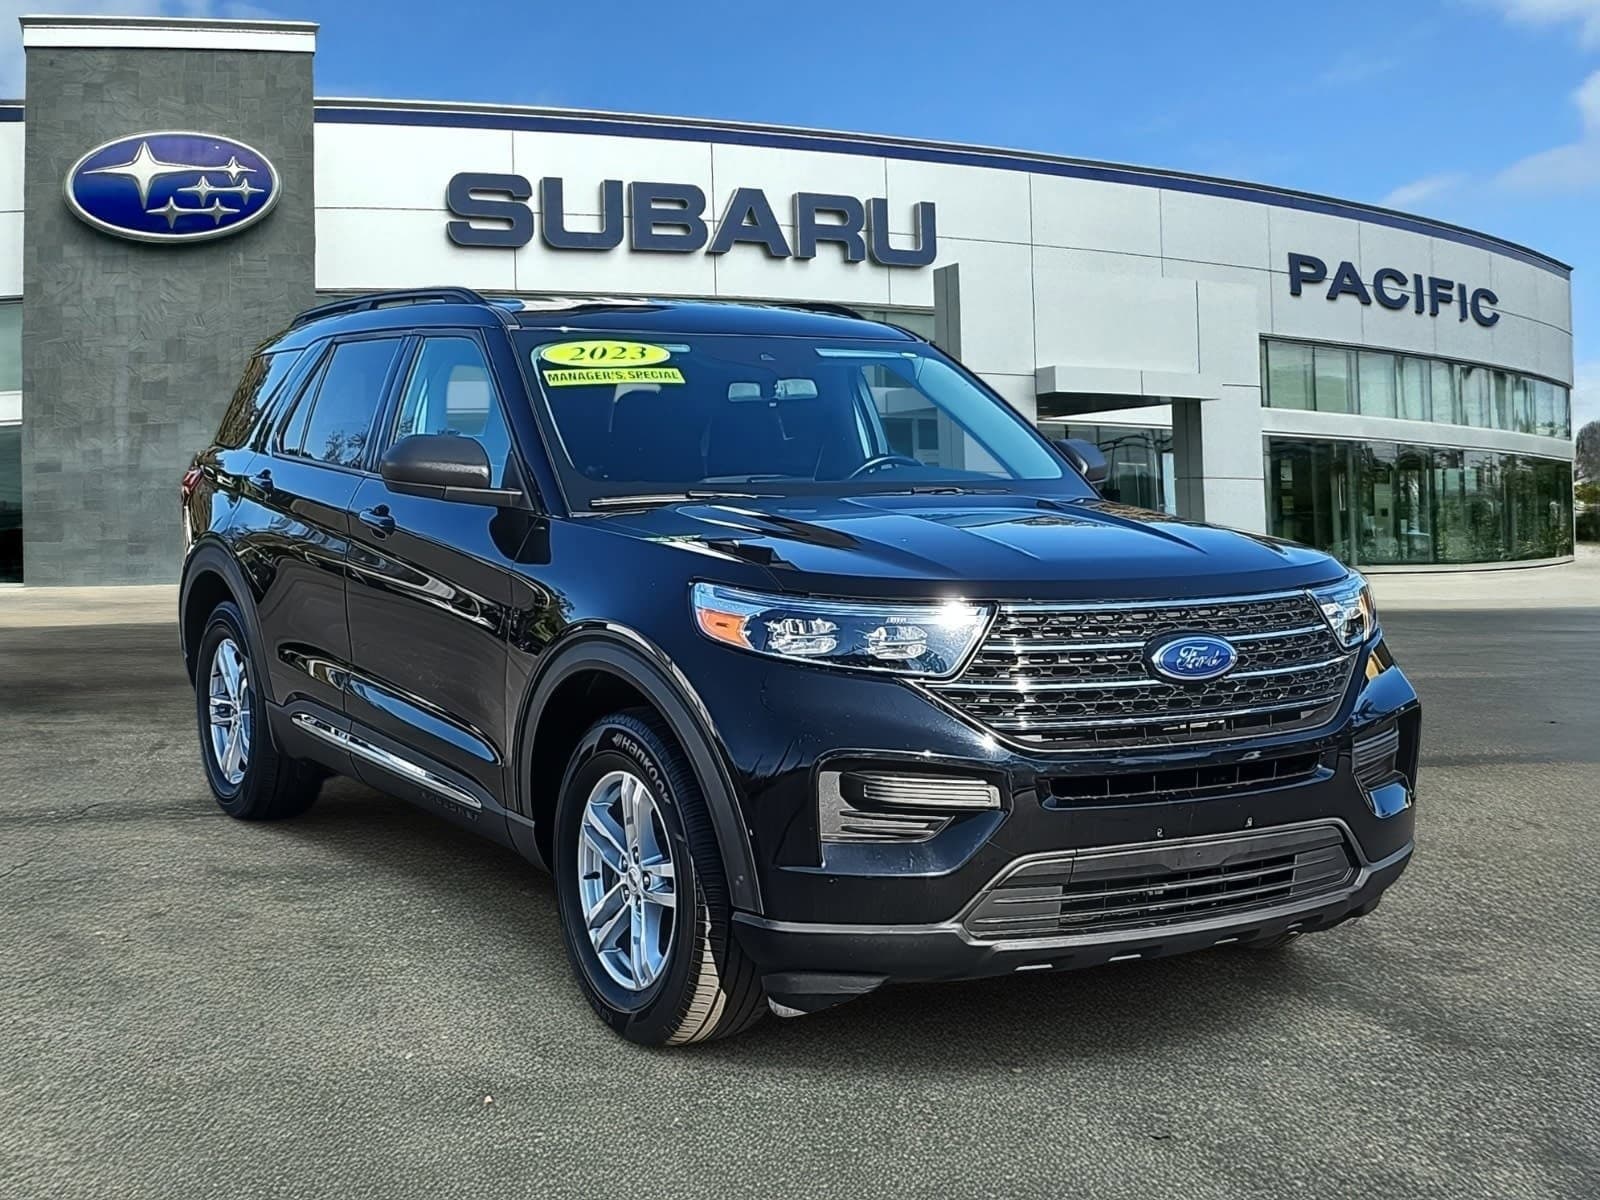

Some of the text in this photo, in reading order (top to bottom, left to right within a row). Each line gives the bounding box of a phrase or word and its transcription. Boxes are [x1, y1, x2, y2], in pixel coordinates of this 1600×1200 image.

[447, 172, 937, 267] SUBARU
[1288, 252, 1500, 328] PACIFIC
[568, 345, 647, 361] 2023
[548, 369, 680, 382] MANAGER'S SPECIAL
[1176, 645, 1223, 670] Ford
